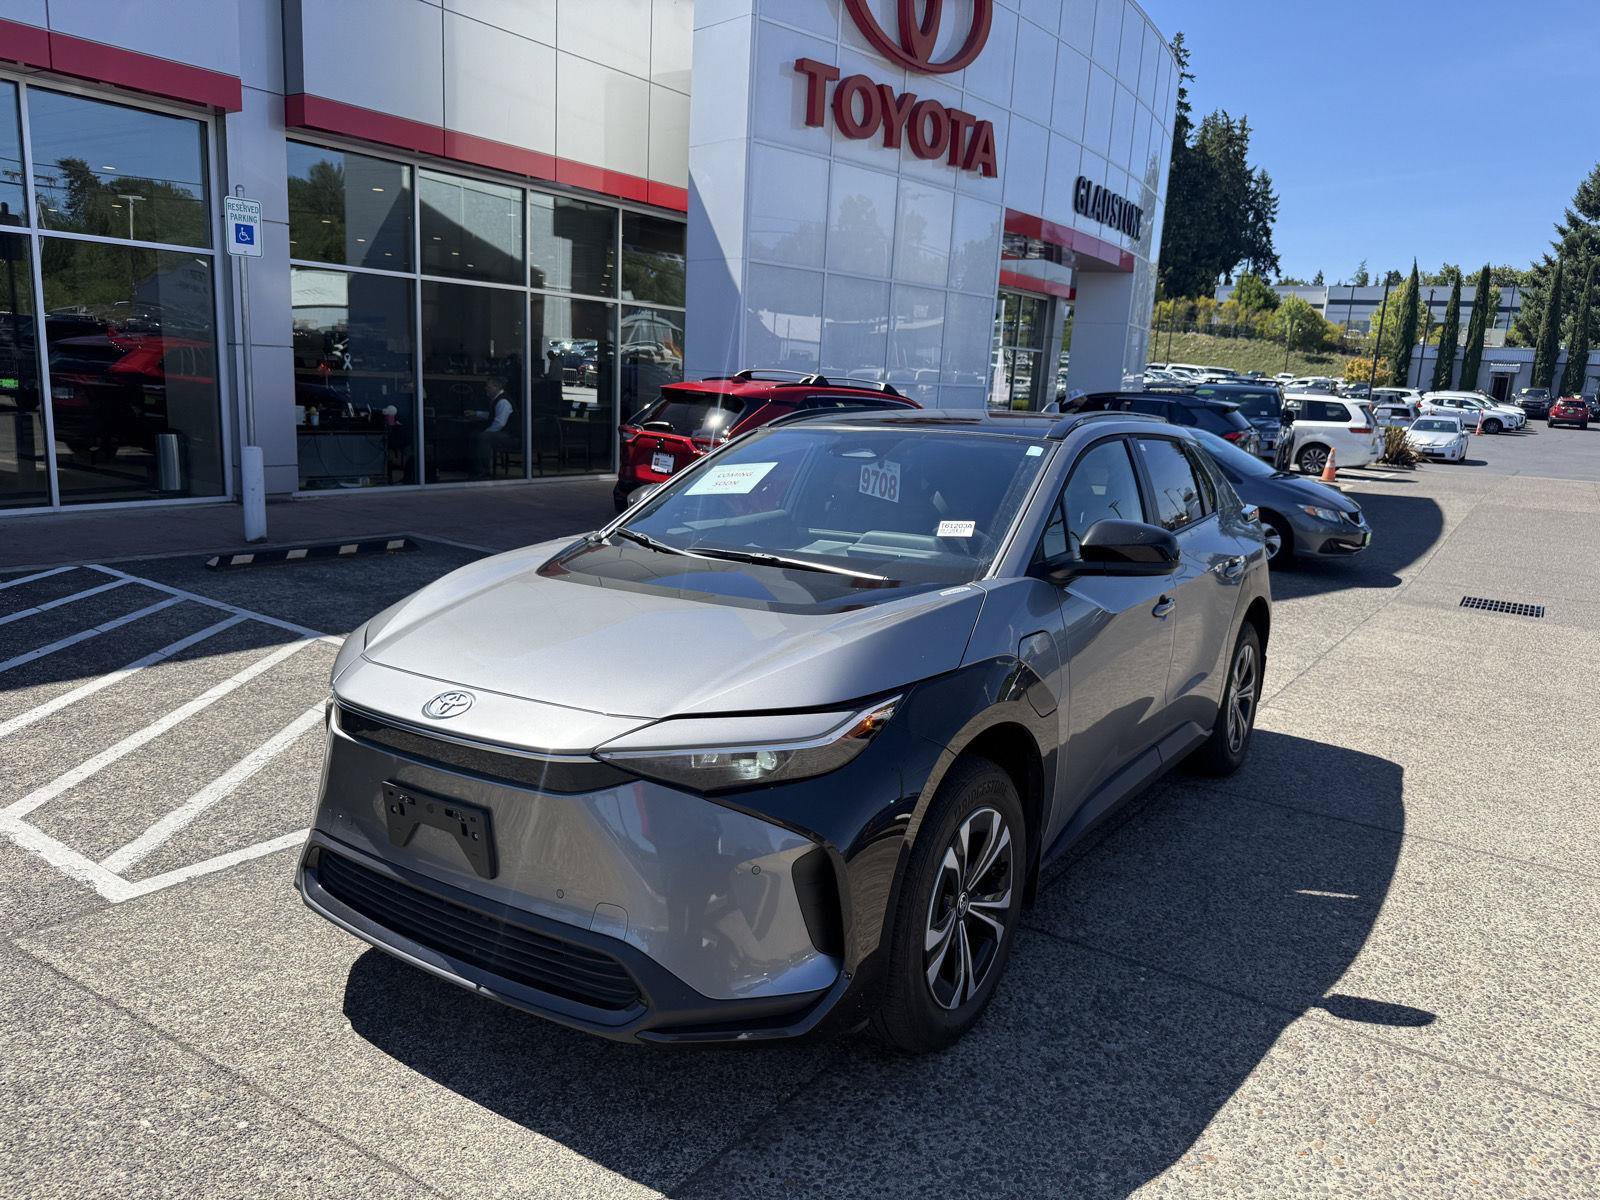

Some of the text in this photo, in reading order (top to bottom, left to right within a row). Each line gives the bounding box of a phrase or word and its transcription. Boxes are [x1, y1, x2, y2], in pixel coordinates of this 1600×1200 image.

[794, 57, 998, 178] TOYOTA
[227, 202, 259, 213] RESERVED
[230, 212, 258, 224] PARKING
[1073, 175, 1143, 241] GLADSTONE
[861, 467, 898, 500] 9708
